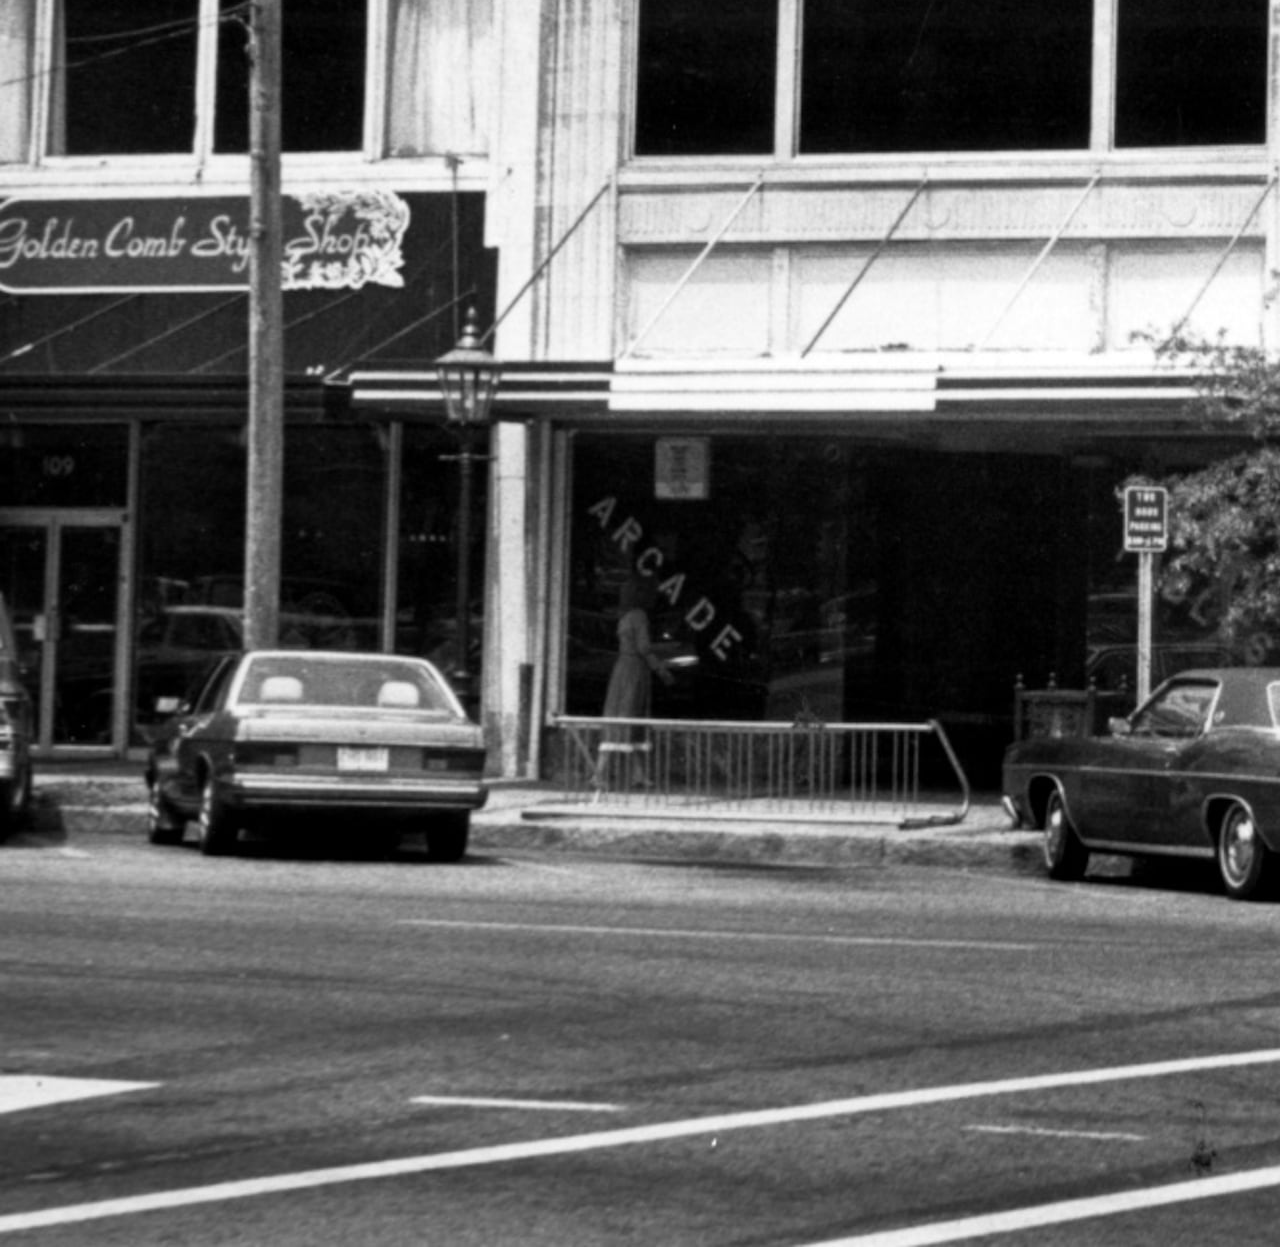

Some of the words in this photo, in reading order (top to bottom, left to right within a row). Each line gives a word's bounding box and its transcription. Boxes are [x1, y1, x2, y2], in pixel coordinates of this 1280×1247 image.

[0, 217, 99, 270] Golden
[104, 215, 187, 258] Comb
[190, 214, 251, 273] Sty
[283, 213, 370, 265] Shop
[43, 454, 76, 477] 109
[587, 496, 743, 662] ARCADE
